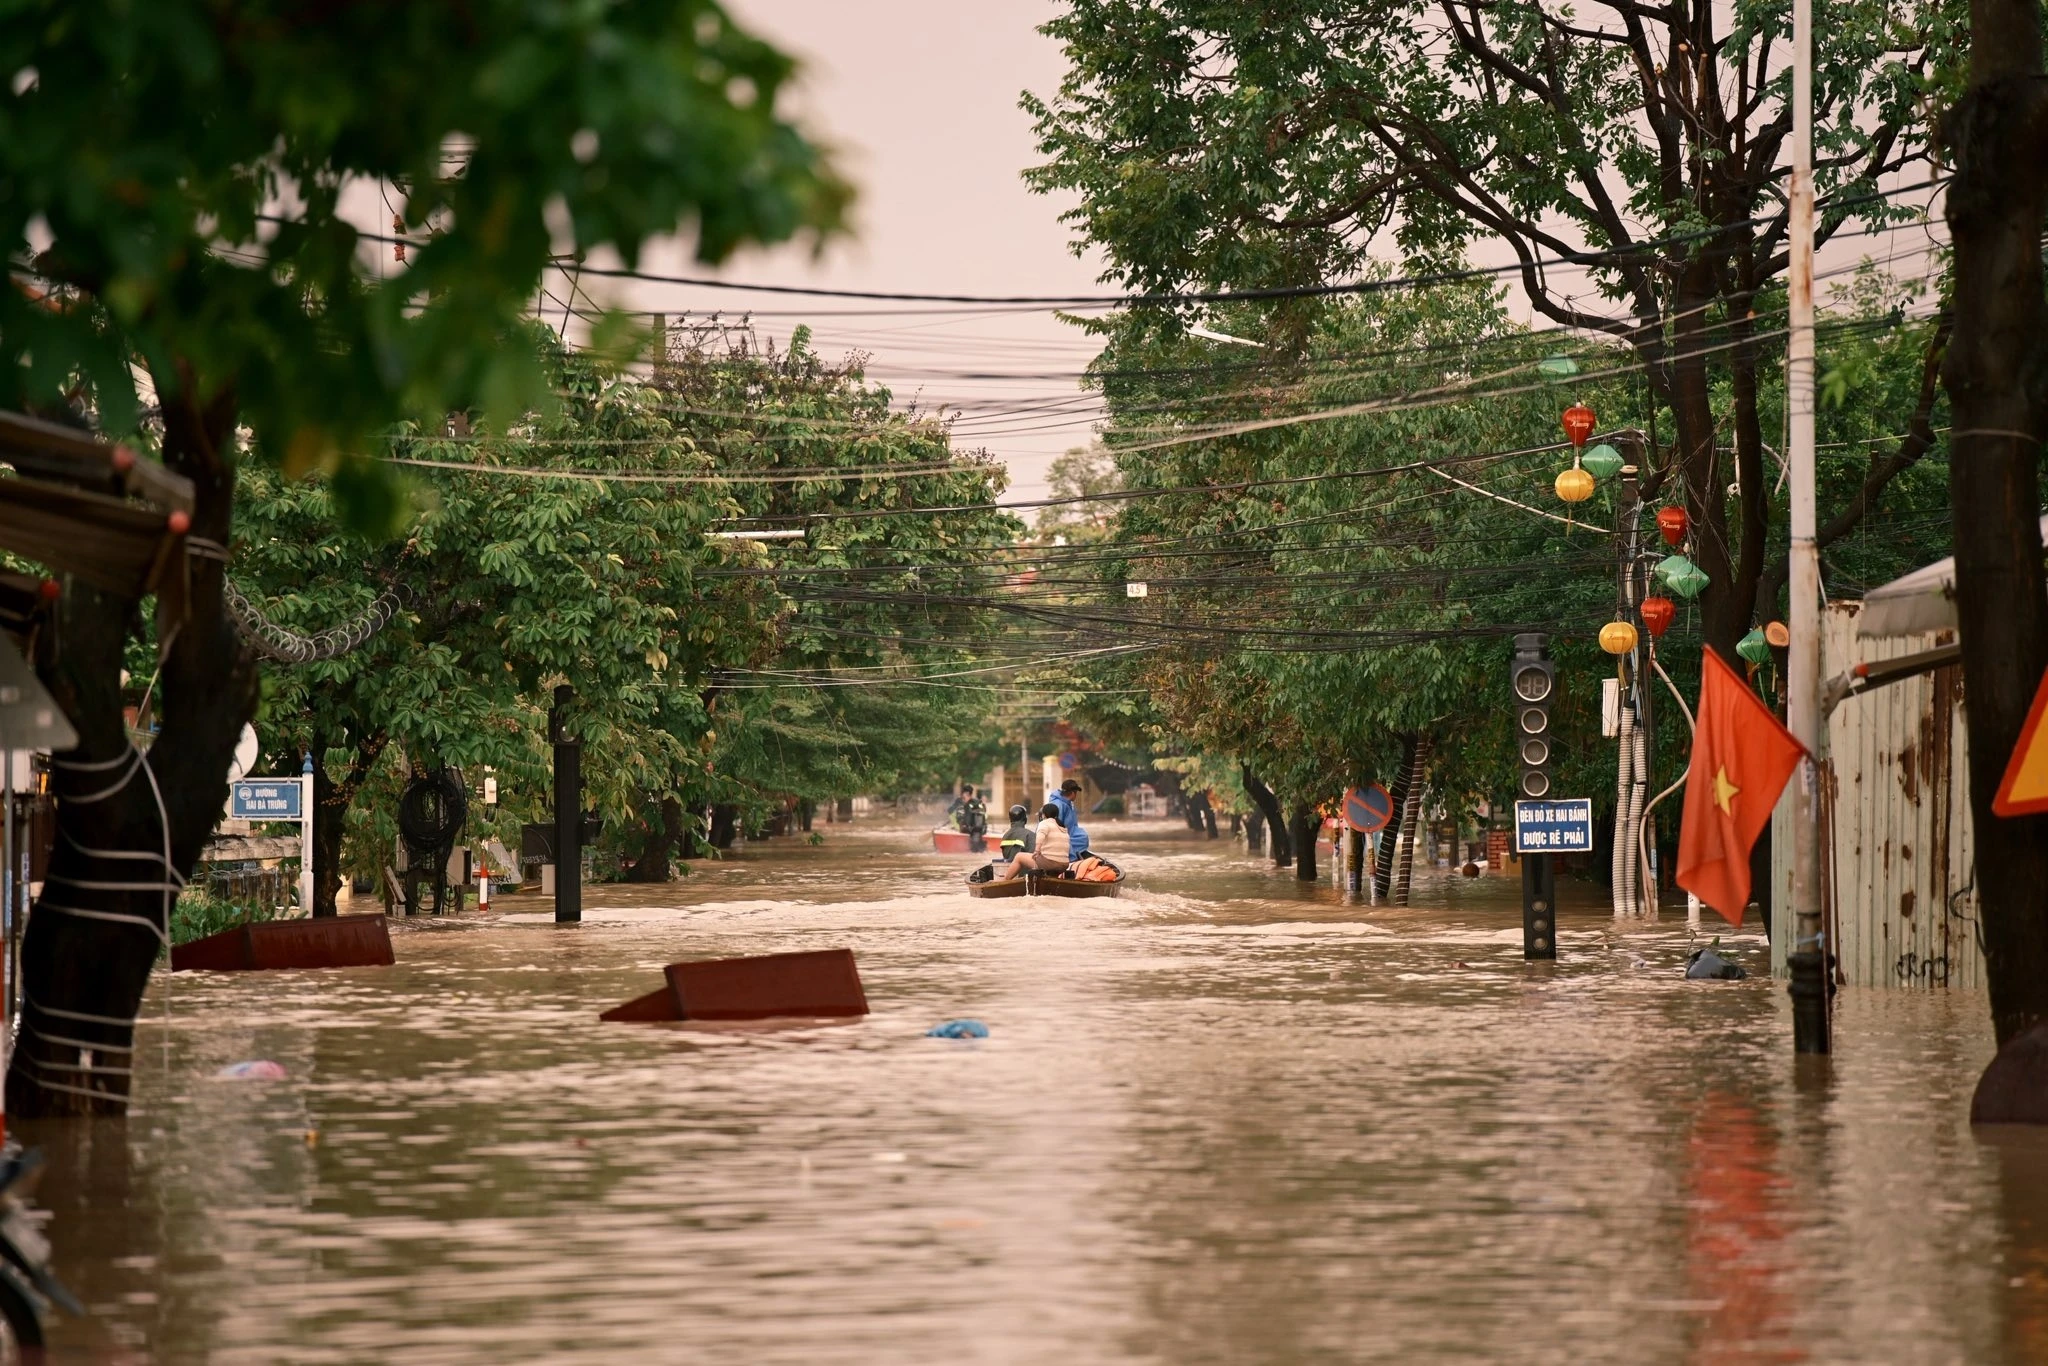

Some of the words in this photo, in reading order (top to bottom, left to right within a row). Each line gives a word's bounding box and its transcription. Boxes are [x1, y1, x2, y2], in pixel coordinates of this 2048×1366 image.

[245, 799, 257, 810] HAI
[257, 798, 266, 810] BÀ
[1519, 806, 1534, 823] ĐÈN
[1534, 804, 1545, 823] ĐỎ
[1545, 809, 1555, 823] XE
[1555, 808, 1567, 822] HAI
[1568, 805, 1588, 822] BÁNH
[1523, 830, 1547, 848] ĐƯỢC
[1563, 826, 1585, 845] PHẢI
